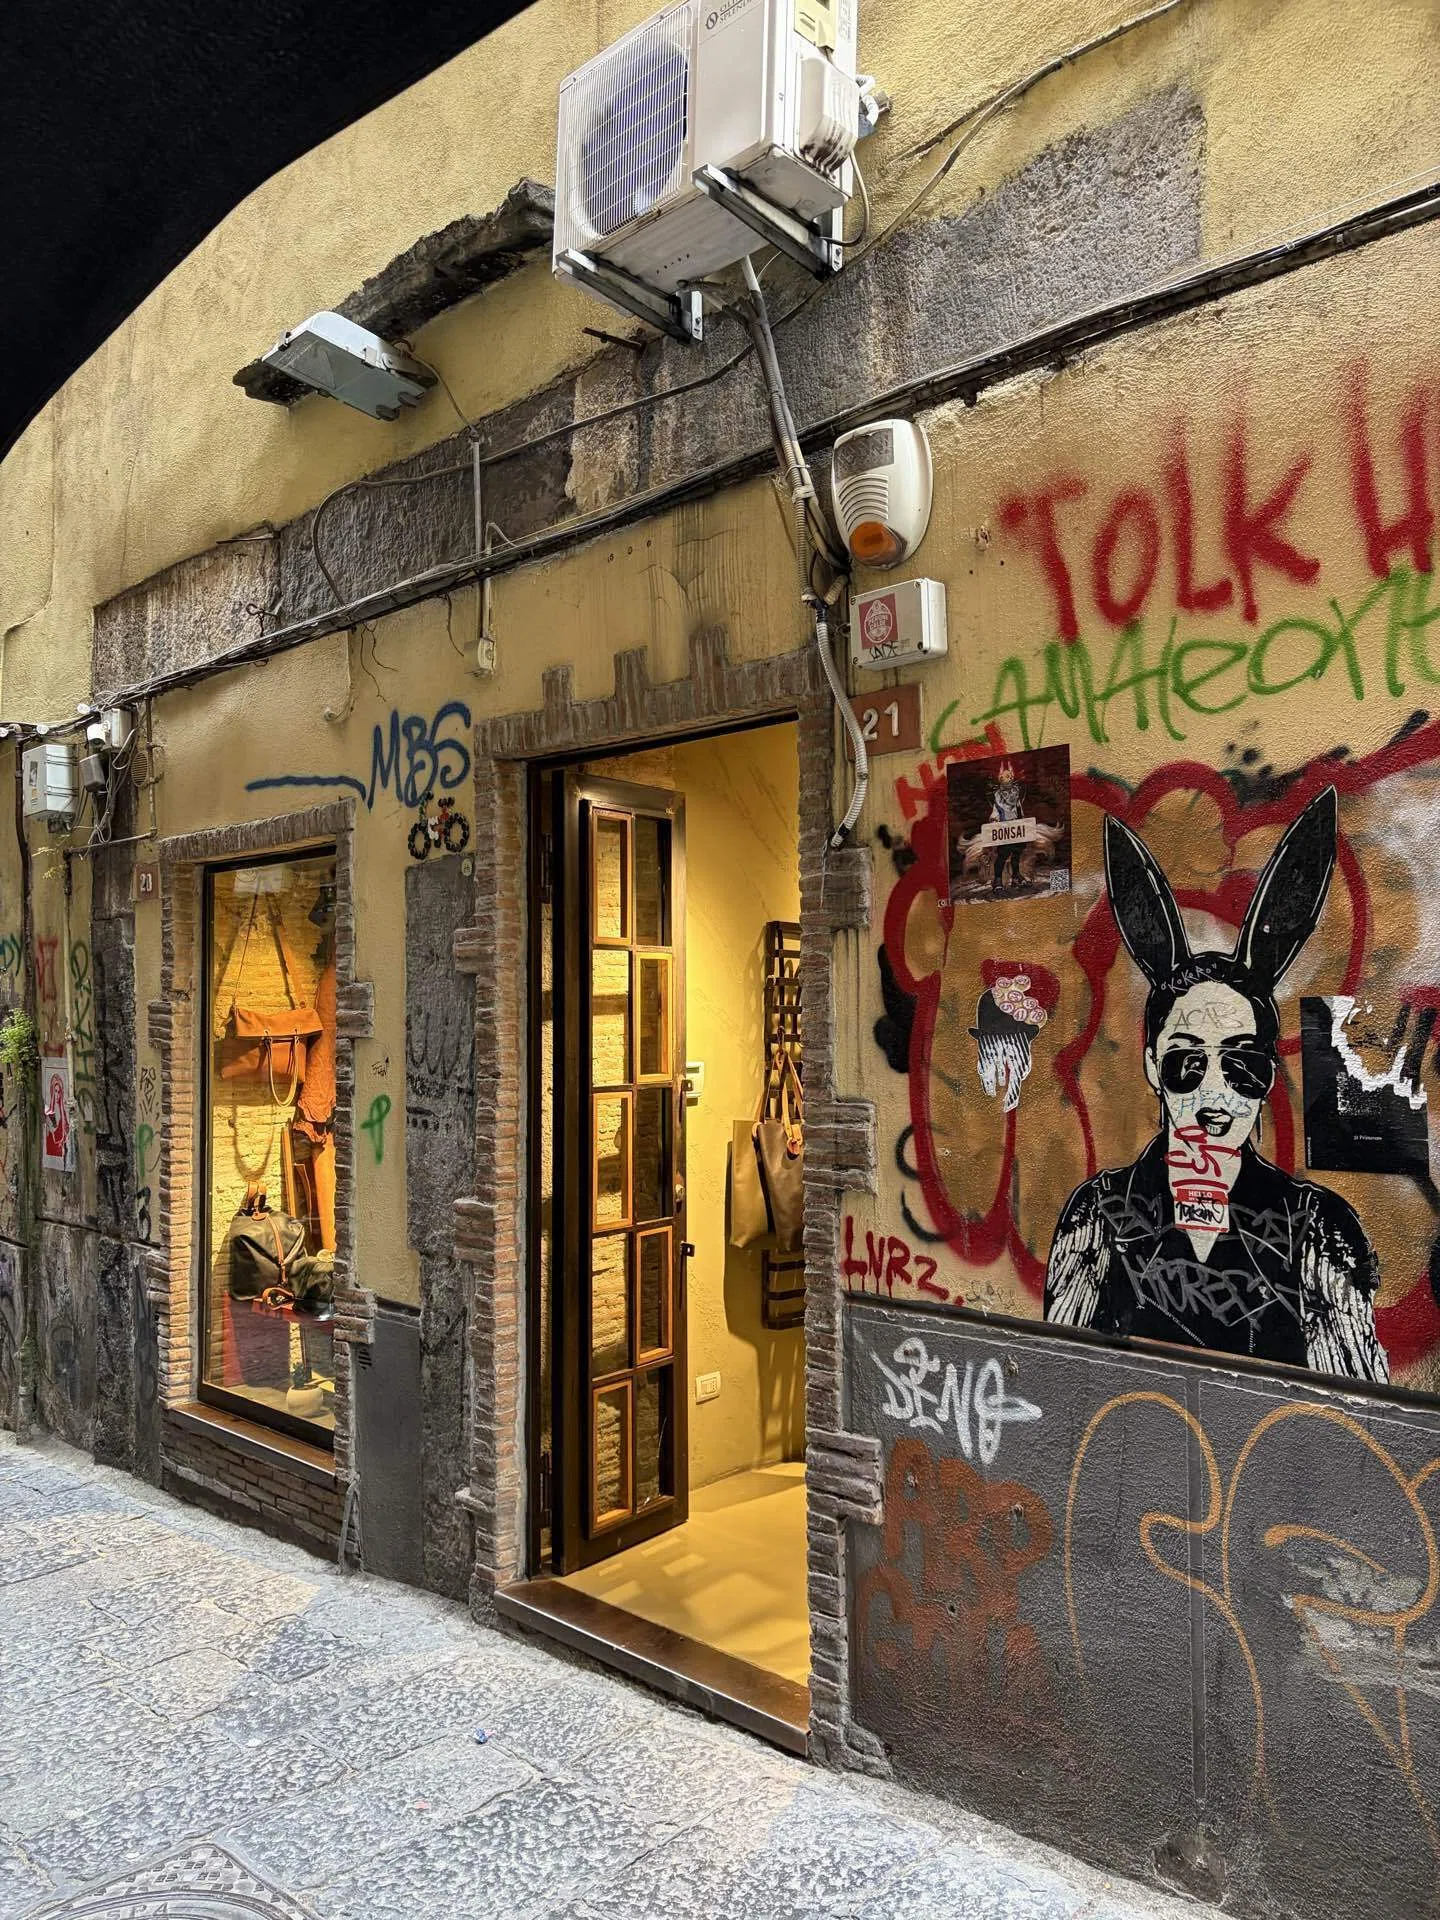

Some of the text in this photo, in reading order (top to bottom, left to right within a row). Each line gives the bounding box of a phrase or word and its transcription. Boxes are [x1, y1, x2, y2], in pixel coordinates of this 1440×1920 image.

[862, 701, 899, 741] 21
[991, 825, 1026, 842] BONSAI
[1173, 1001, 1244, 1032] ACAB
